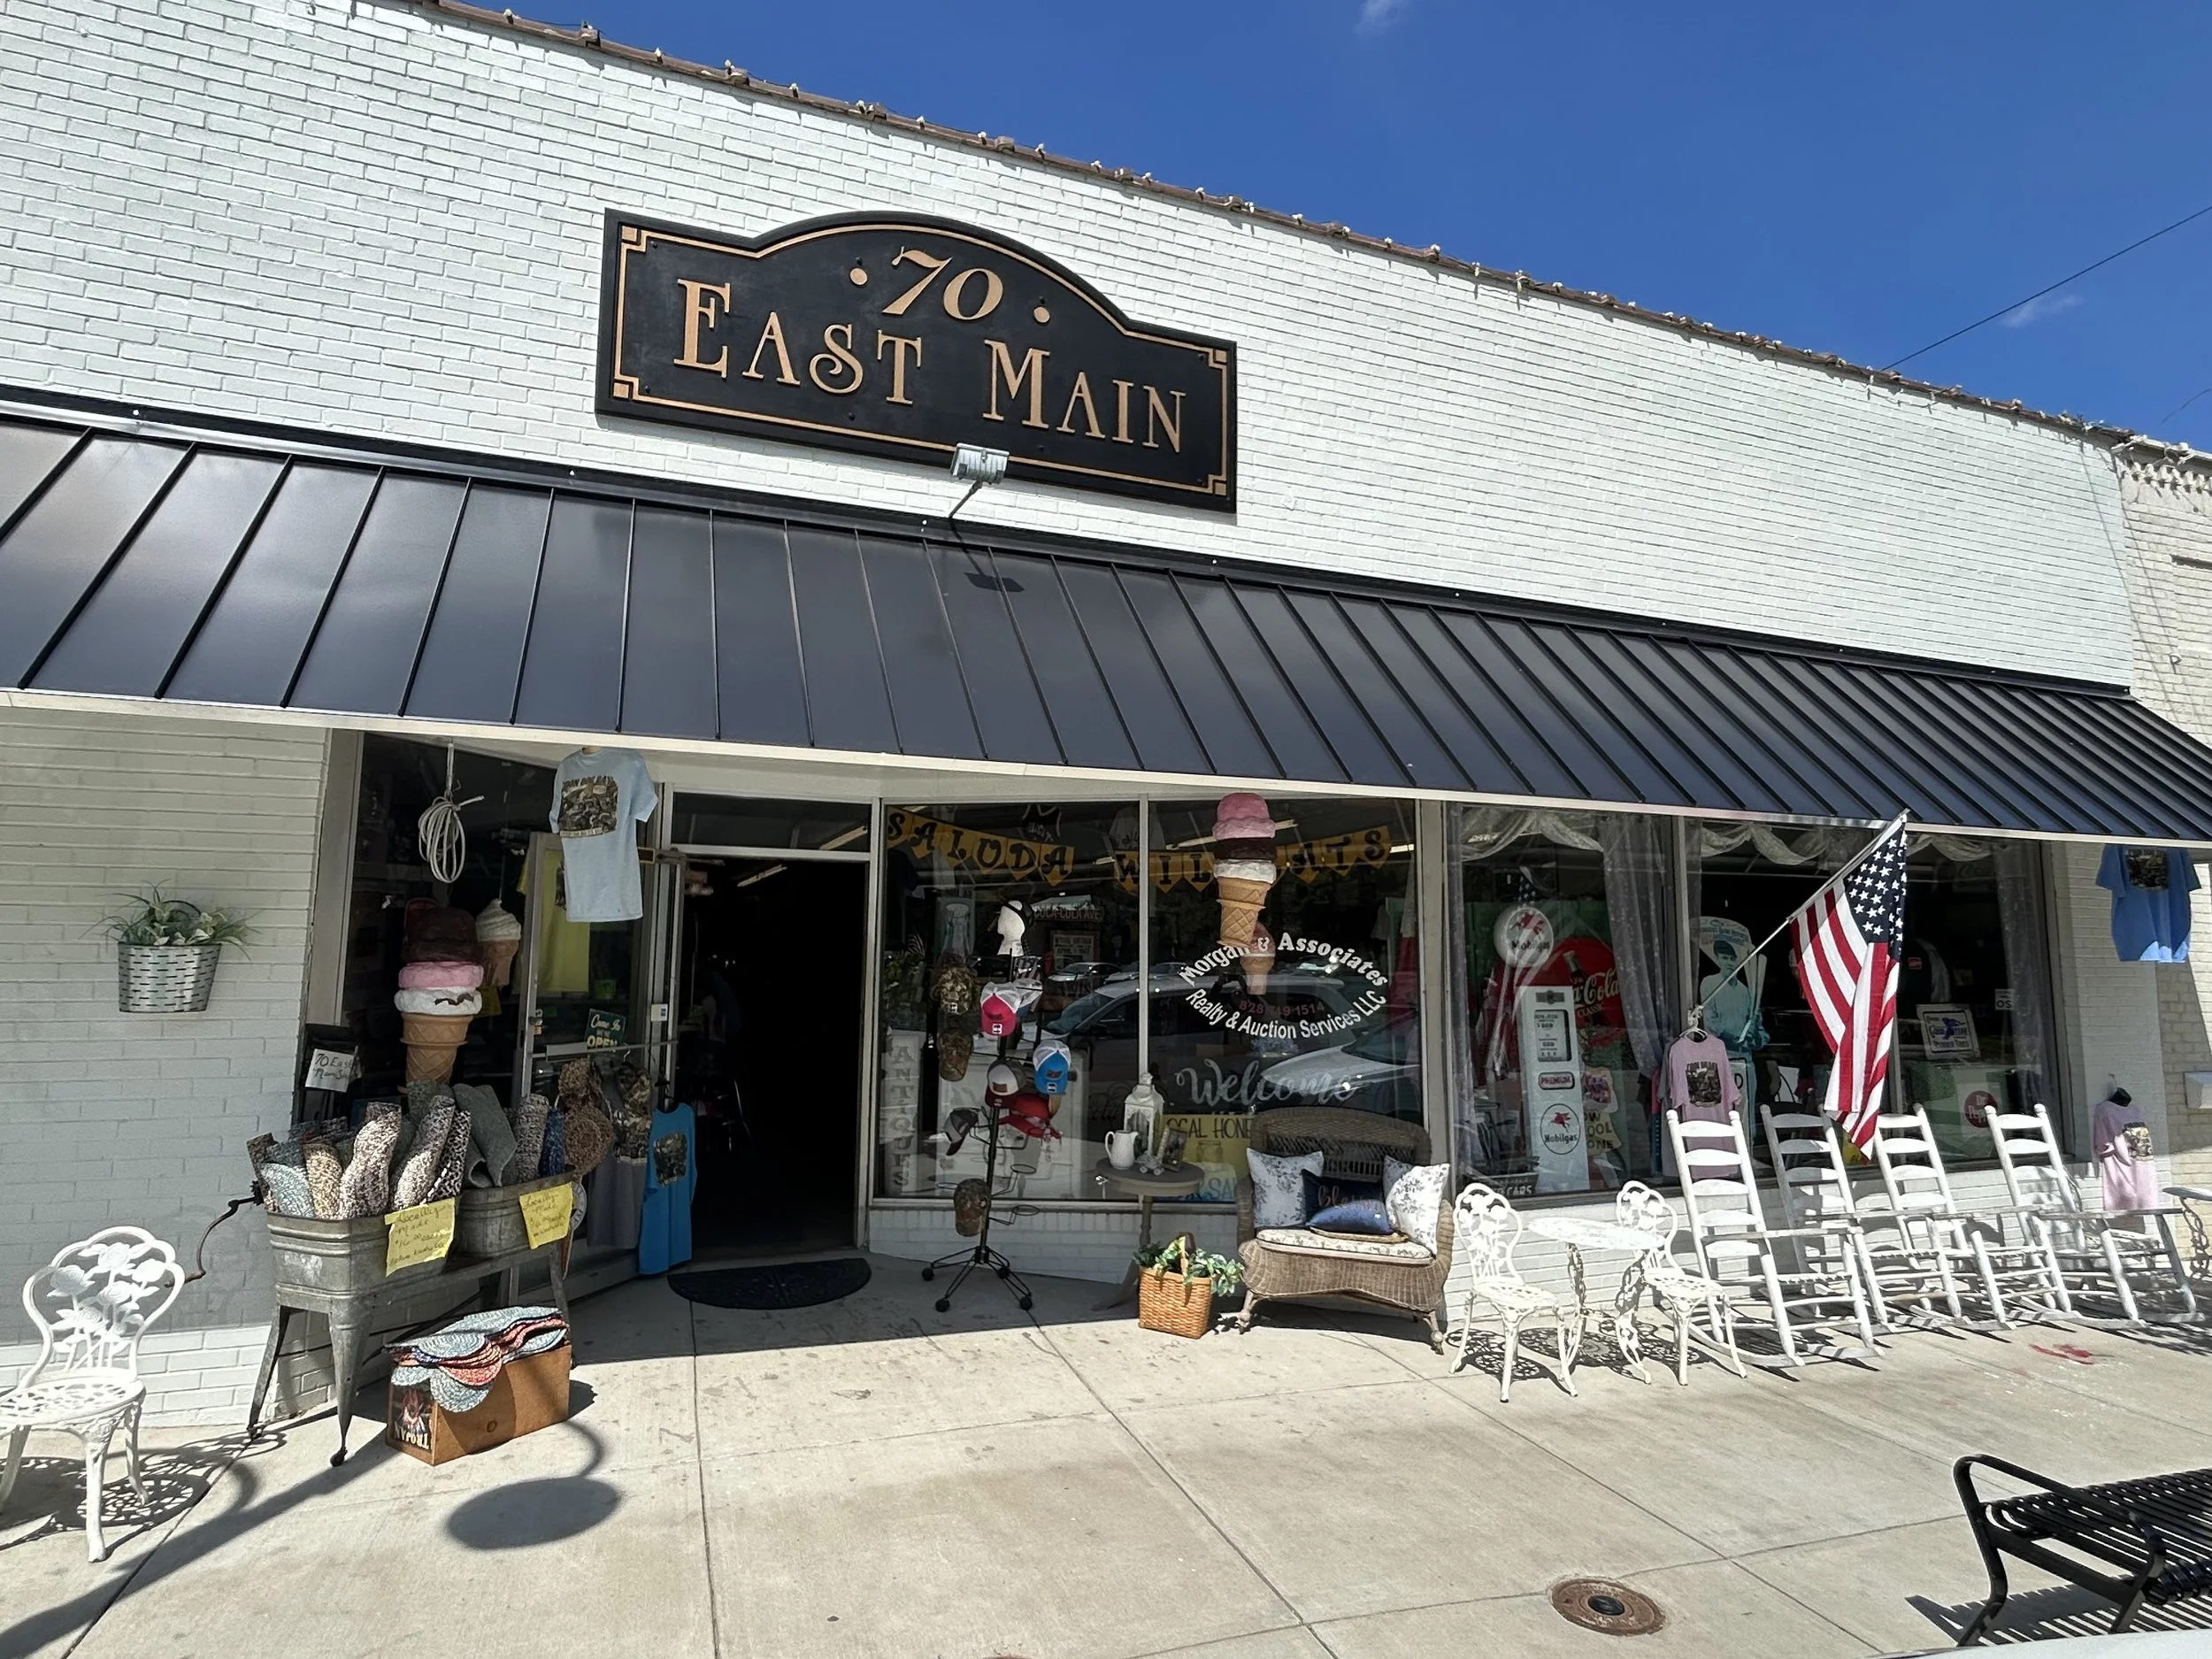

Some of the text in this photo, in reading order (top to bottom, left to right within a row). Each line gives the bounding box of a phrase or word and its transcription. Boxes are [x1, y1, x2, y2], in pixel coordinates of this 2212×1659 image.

[882, 246, 1004, 321] 70
[673, 279, 1186, 453] EAST MAIN
[887, 812, 1385, 885] SALUDA WILATS
[1177, 932, 1388, 987] Morgan & Associates
[1185, 988, 1387, 1040] Realty & Auction Services LLC
[587, 1034, 618, 1048] OPEN
[315, 1053, 352, 1069] 70 East
[1174, 1057, 1355, 1107] Welcome
[1540, 1075, 1571, 1085] PREMIUM
[1968, 1104, 1986, 1124] Pepp
[1166, 1117, 1254, 1139] OCAL HONE
[1544, 1133, 1578, 1144] Mobilgas
[1586, 1139, 1614, 1149] ONE
[1506, 1185, 1533, 1196] CARS
